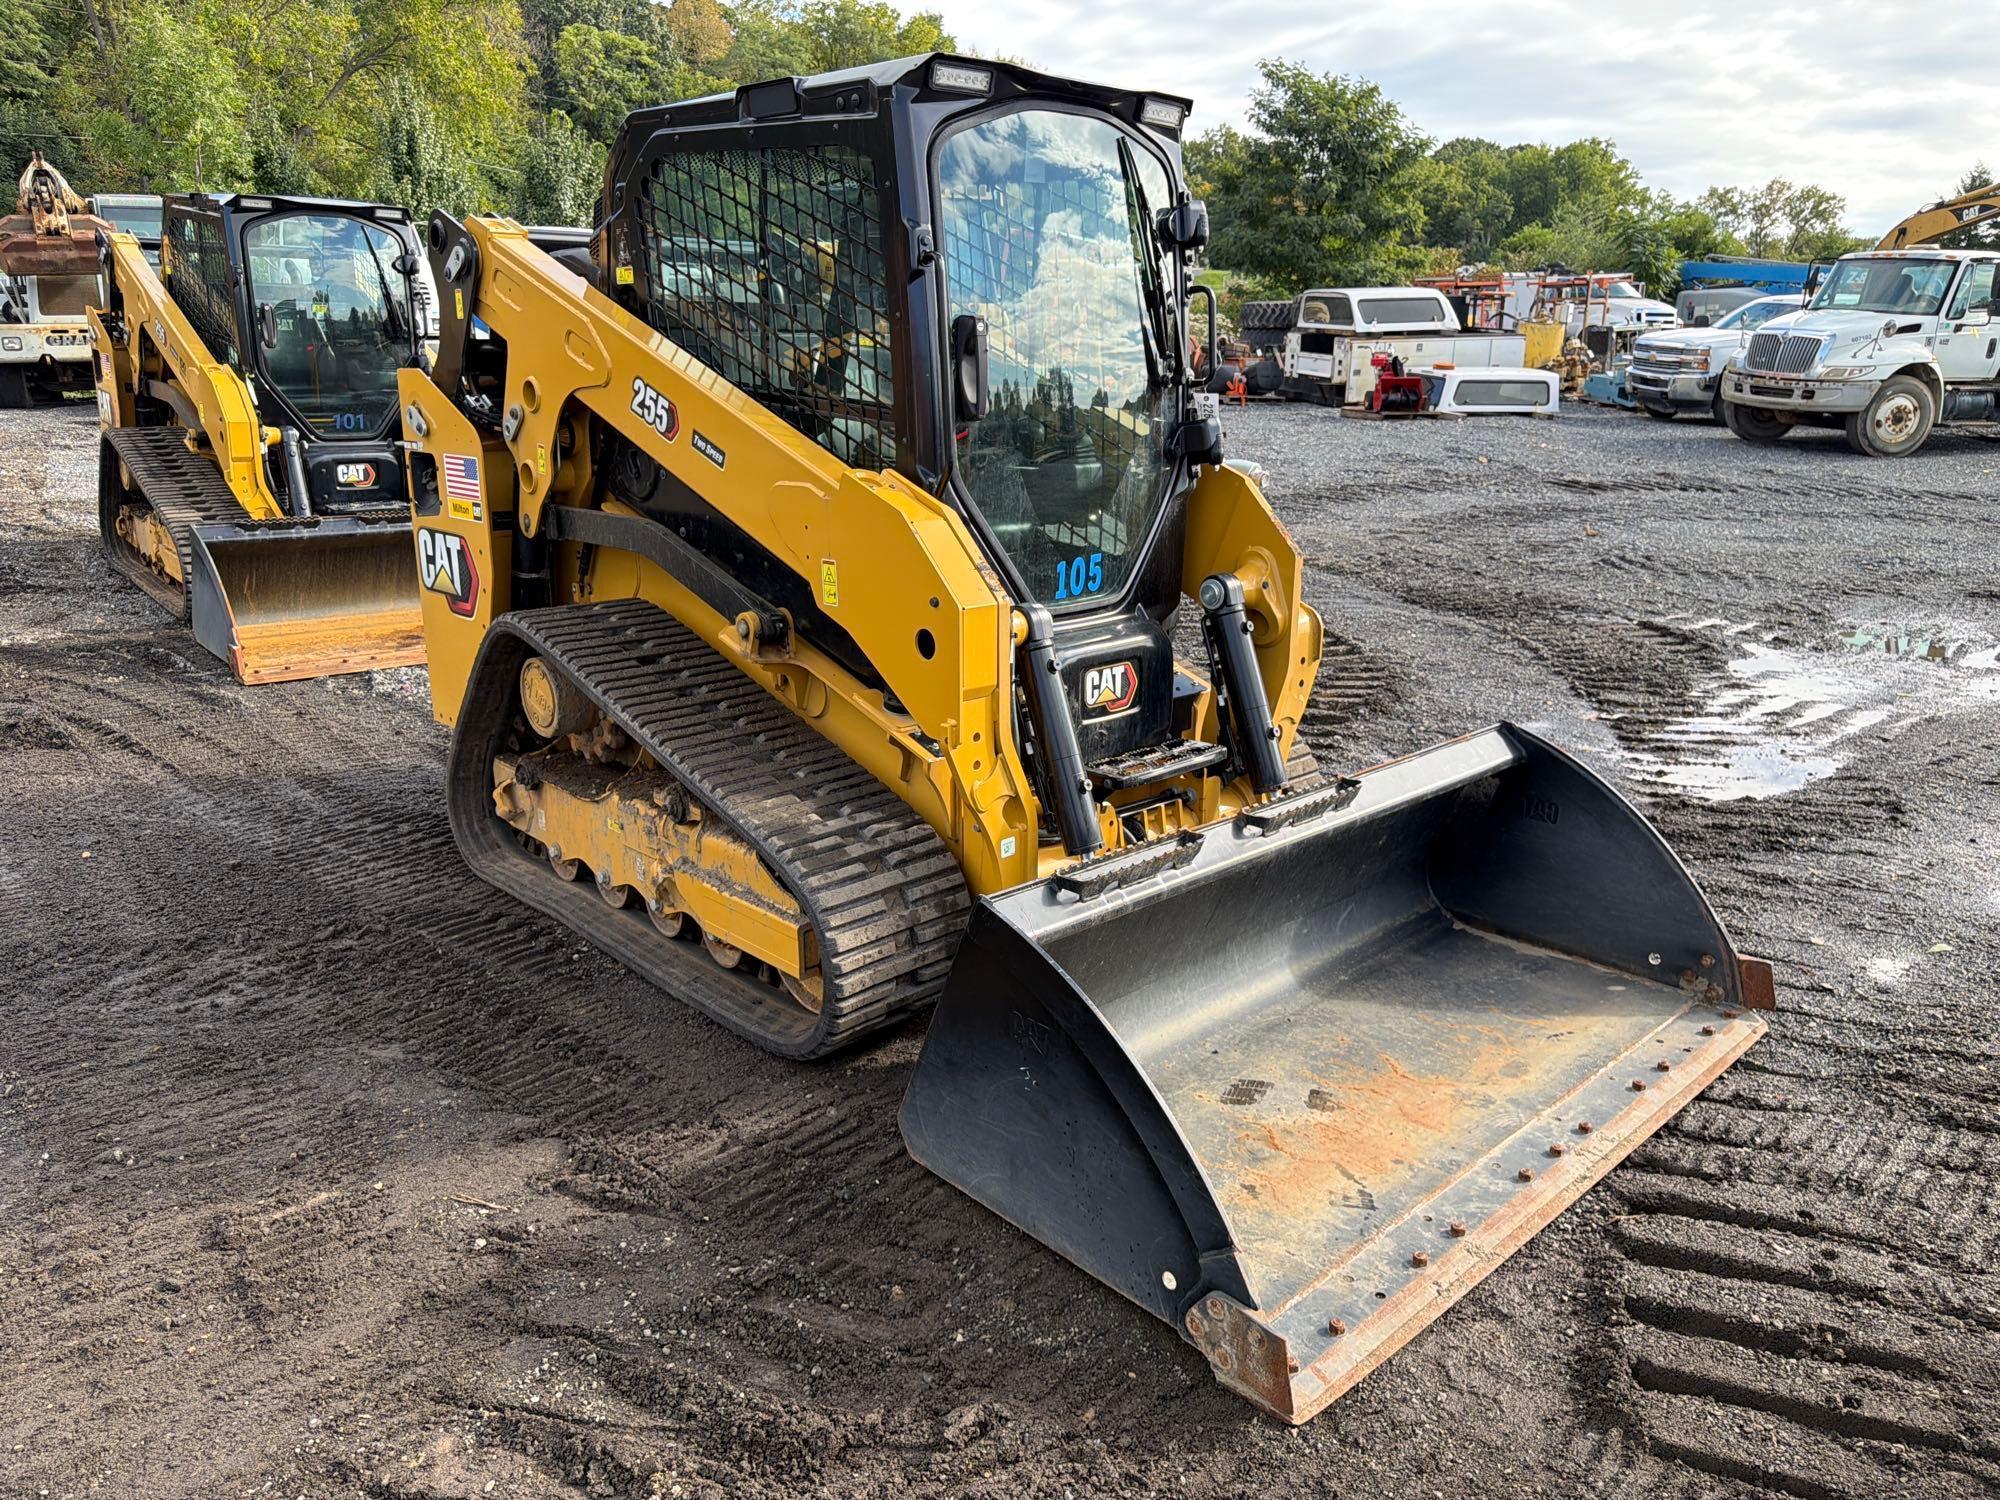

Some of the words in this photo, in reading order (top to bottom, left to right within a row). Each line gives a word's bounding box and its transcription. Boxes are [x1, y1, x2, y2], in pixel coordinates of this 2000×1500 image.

[1963, 205, 1980, 221] CAT
[49, 334, 88, 346] GRA
[632, 378, 670, 433] 255
[333, 413, 365, 430] 101
[337, 464, 365, 483] CAT
[452, 502, 470, 514] Milton
[418, 528, 461, 597] CAT
[1055, 553, 1102, 600] 105
[1086, 665, 1126, 706] CAT
